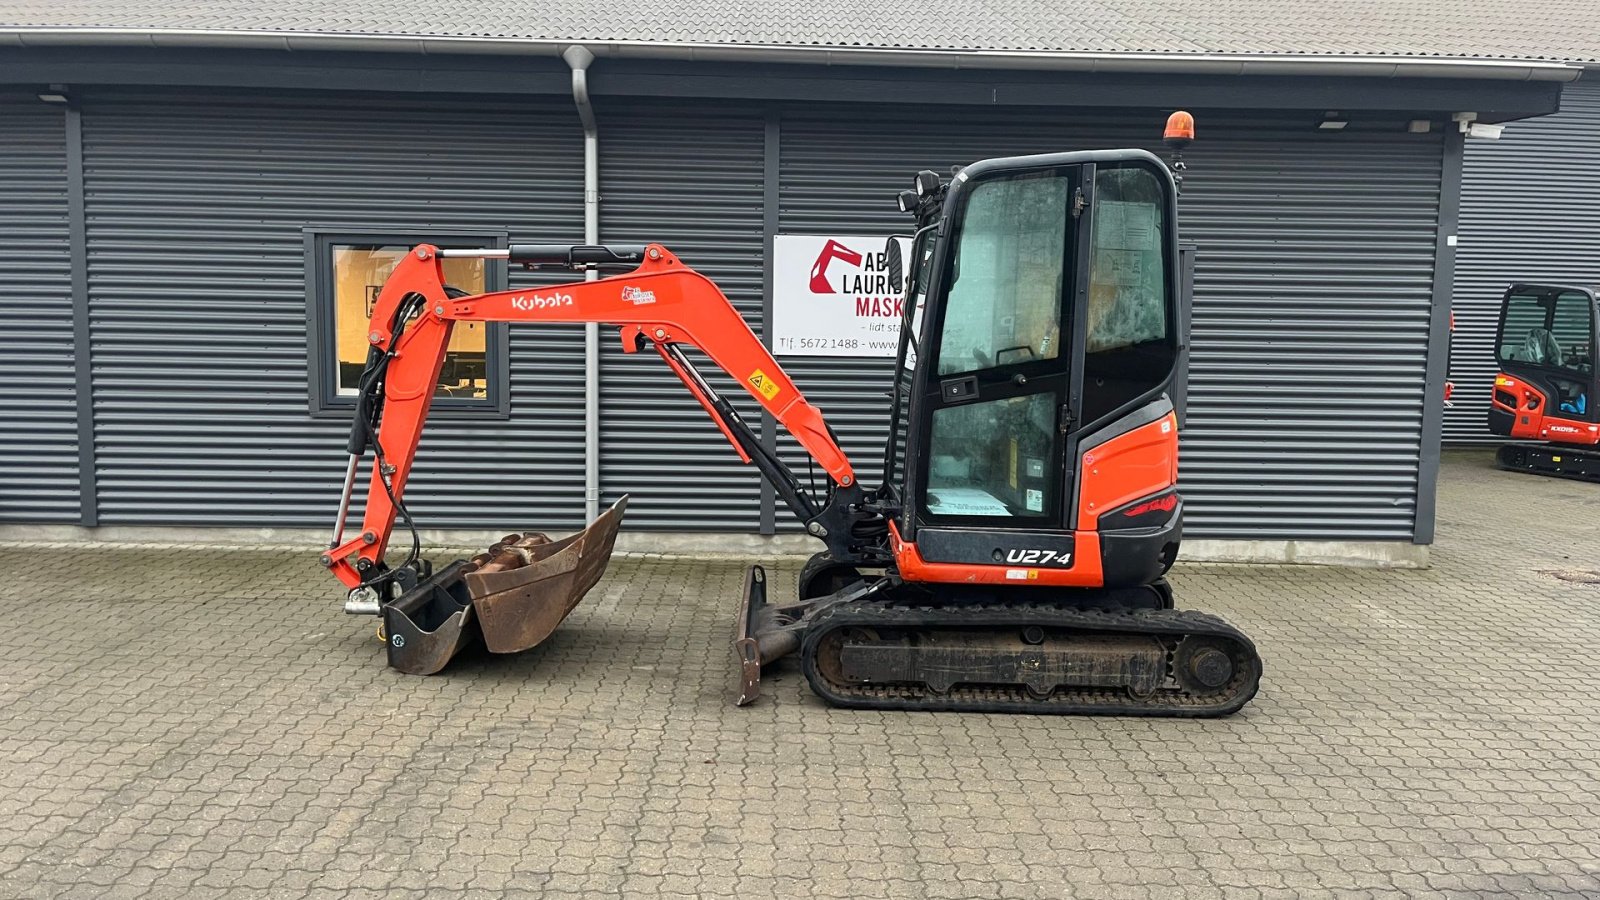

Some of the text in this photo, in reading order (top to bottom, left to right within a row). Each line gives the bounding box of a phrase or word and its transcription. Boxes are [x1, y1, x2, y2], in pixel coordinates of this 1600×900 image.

[511, 292, 573, 311] Kubota
[869, 322, 885, 332] lidt
[780, 337, 796, 350] Tlf.
[800, 338, 828, 349] 5672
[831, 338, 858, 349] 1488
[1006, 549, 1071, 565] U27-4
